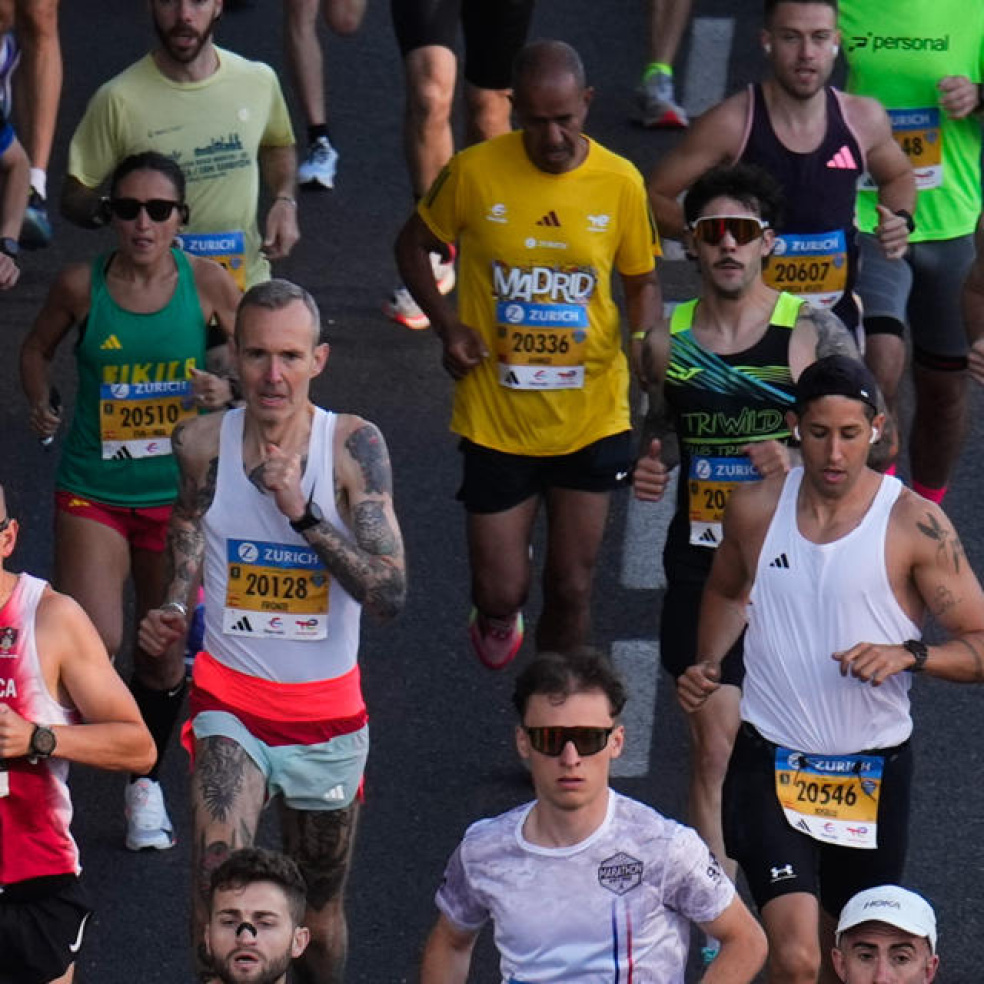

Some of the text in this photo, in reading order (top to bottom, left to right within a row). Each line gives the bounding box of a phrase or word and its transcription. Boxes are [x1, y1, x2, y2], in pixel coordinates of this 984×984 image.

[872, 35, 950, 51] personal
[188, 235, 236, 249] ZURICH
[790, 235, 839, 251] ZURICH
[774, 261, 830, 284] 20607
[494, 264, 596, 304] MADRID
[528, 309, 580, 322] ZURICH
[512, 331, 570, 353] 20336
[134, 380, 187, 395] ZURICH
[120, 404, 179, 428] 20510
[264, 548, 319, 565] ZURICH
[245, 572, 309, 600] 20128
[796, 779, 857, 807] 20546
